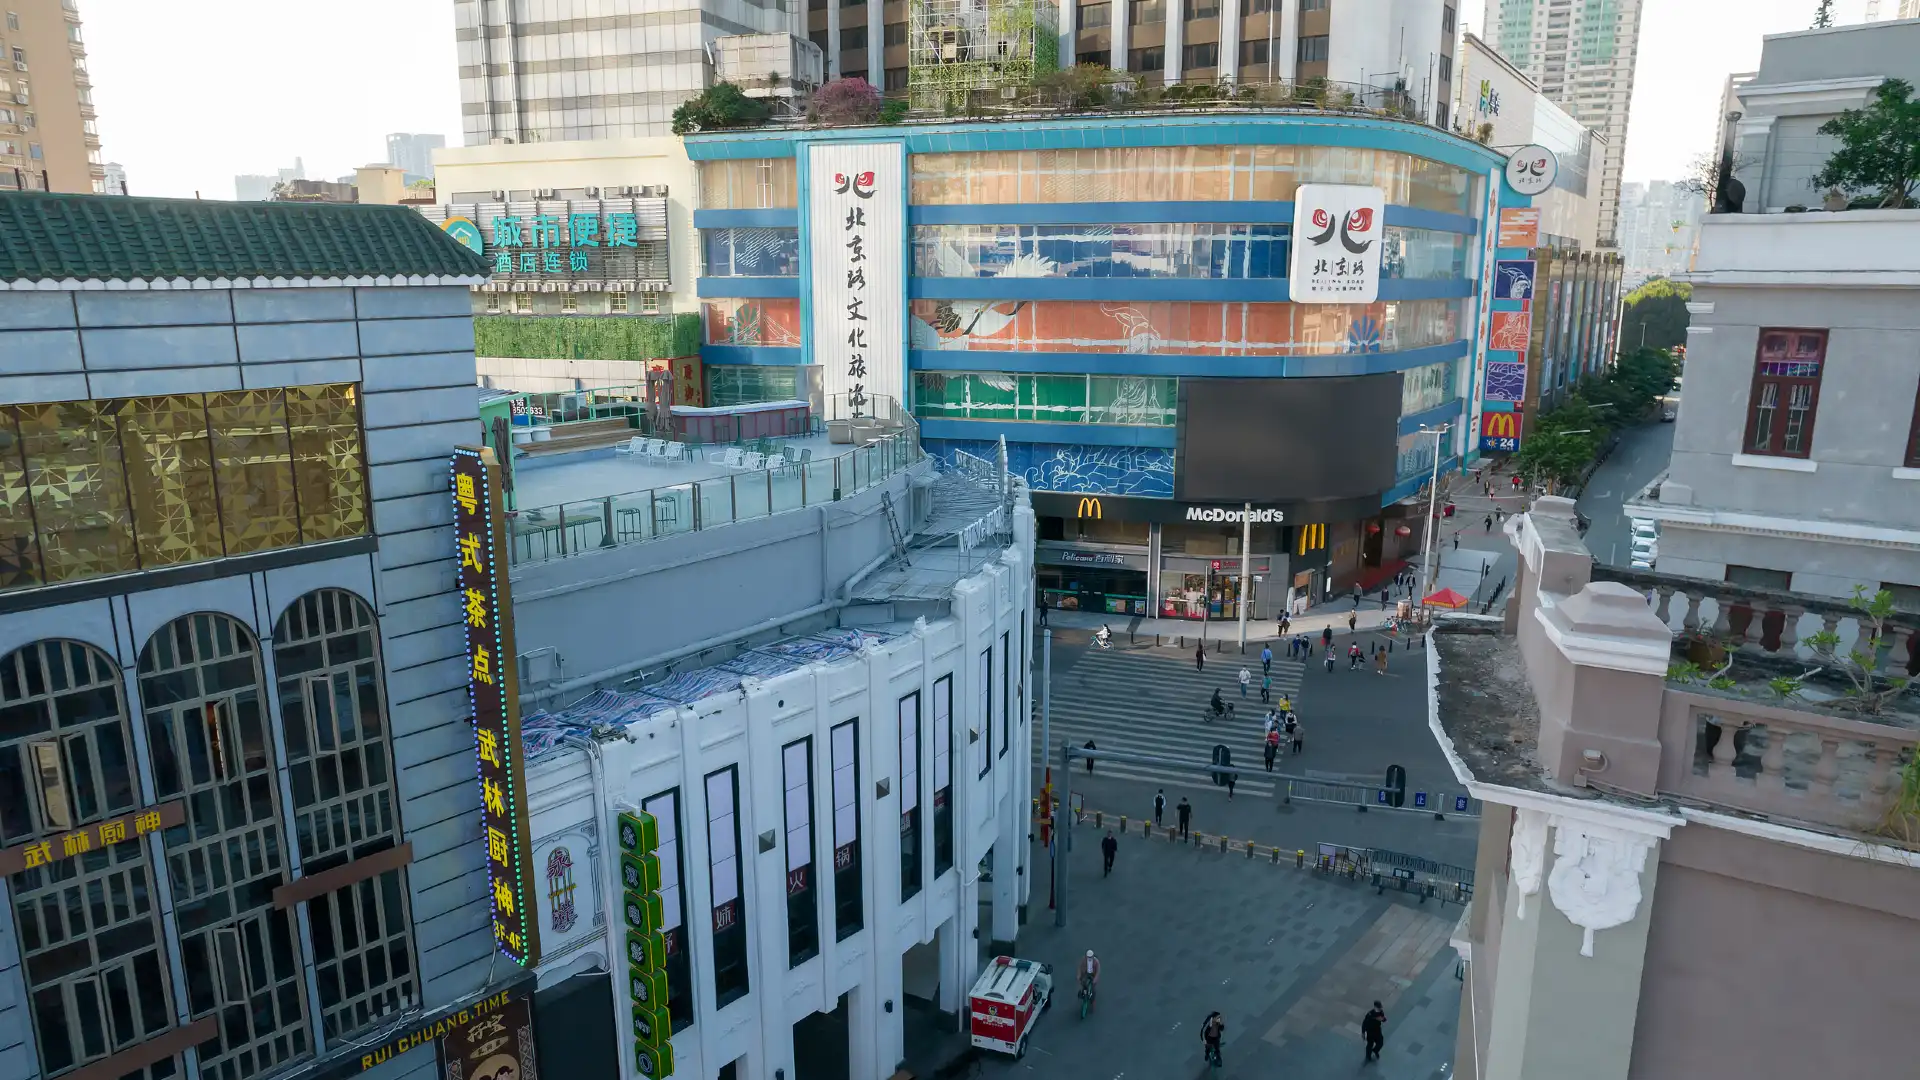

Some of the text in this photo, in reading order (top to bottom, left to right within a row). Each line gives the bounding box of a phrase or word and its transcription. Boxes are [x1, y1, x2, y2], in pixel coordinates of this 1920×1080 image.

[491, 213, 639, 249] 城市便捷
[494, 251, 588, 273] 酒店连锁
[845, 206, 868, 419] 北京路文化旅游
[1500, 438, 1514, 448] 24
[1186, 507, 1284, 522] McDonald's
[456, 473, 492, 686] 粤式茶点
[478, 728, 514, 917] 武林厨神
[361, 1045, 393, 1071] RUI
